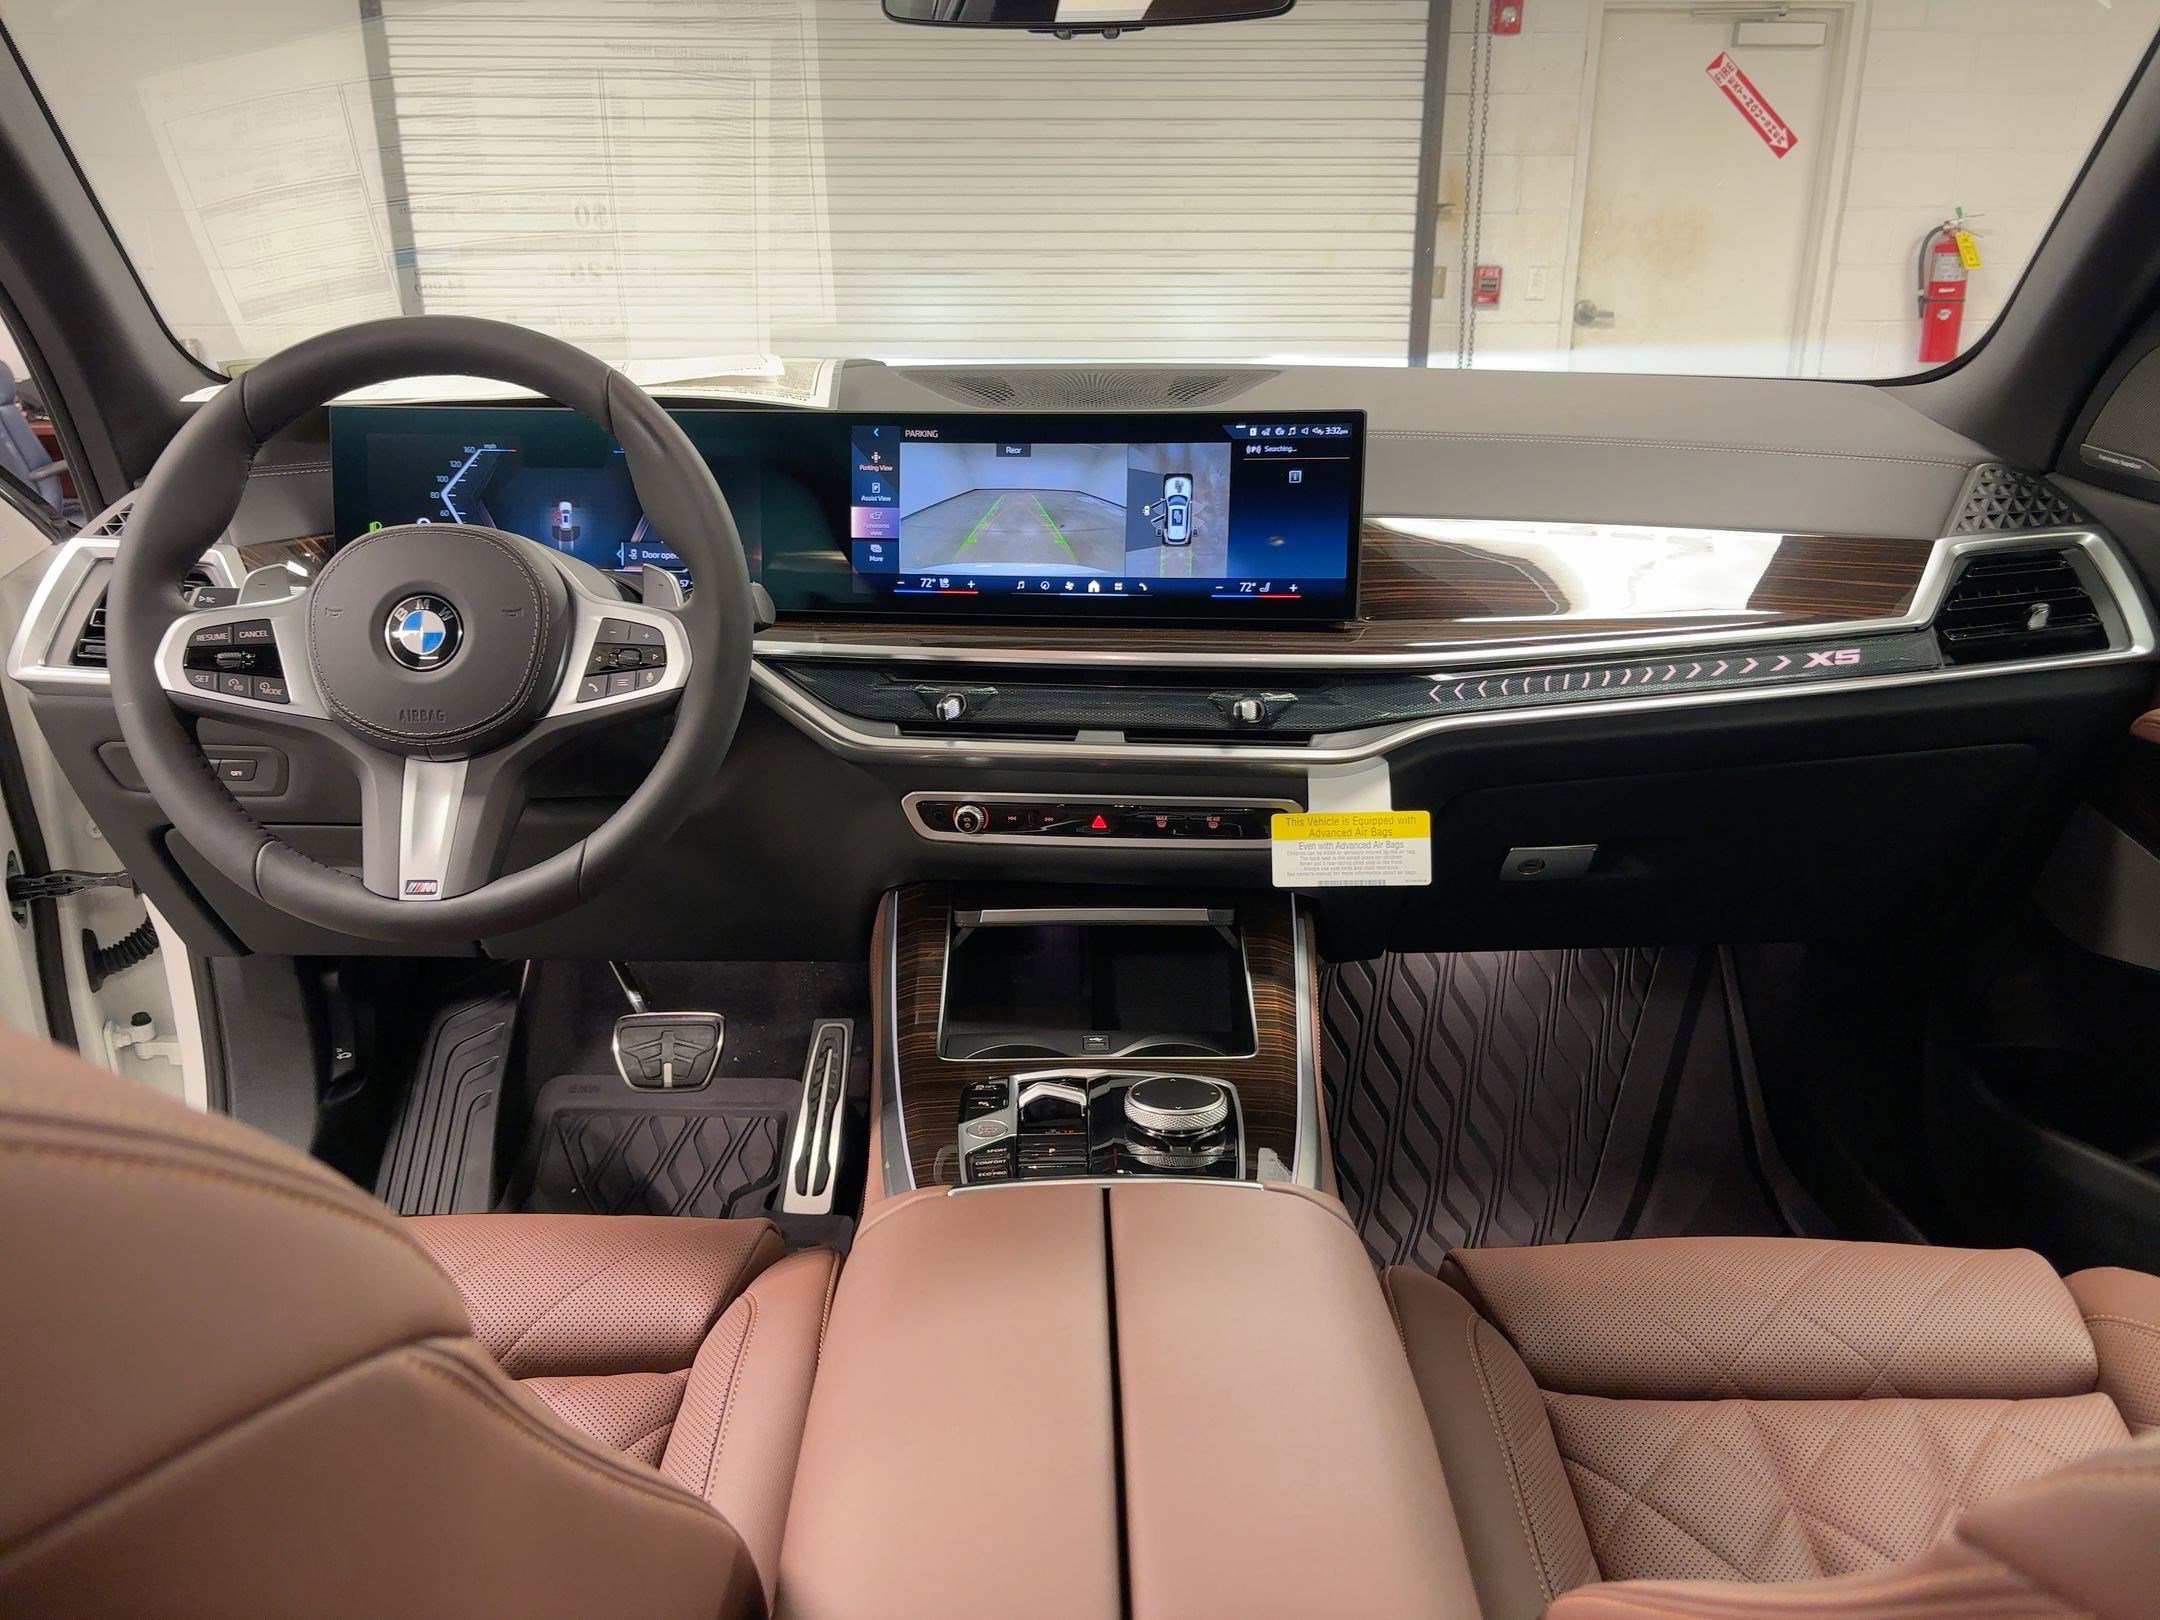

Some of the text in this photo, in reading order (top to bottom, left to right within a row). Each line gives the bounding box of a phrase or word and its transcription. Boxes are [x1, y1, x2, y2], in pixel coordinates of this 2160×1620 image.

[1714, 61, 1735, 84] FIRE
[905, 429, 939, 439] PARKING
[464, 446, 476, 454] 160
[1006, 446, 1022, 455] Rear
[450, 460, 462, 468] 120
[859, 464, 893, 472] Parking View
[436, 475, 449, 483] 100
[430, 491, 440, 499] 80
[440, 509, 450, 517] 60
[642, 551, 660, 559] Door
[869, 555, 883, 563] More
[394, 598, 454, 622] BMW
[196, 632, 229, 642] RESUME
[238, 629, 269, 639] CANCEL
[1802, 648, 1861, 669] X5
[195, 675, 210, 683] SET
[261, 687, 283, 696] MODE
[399, 708, 447, 724] AIRBAG
[1286, 815, 1416, 827] This Vehicle is Equipped with
[1308, 827, 1393, 838] Advanced Air Bags
[1298, 840, 1404, 850] Even with Advanced Air Bags
[975, 1159, 1007, 1167] COMFORT
